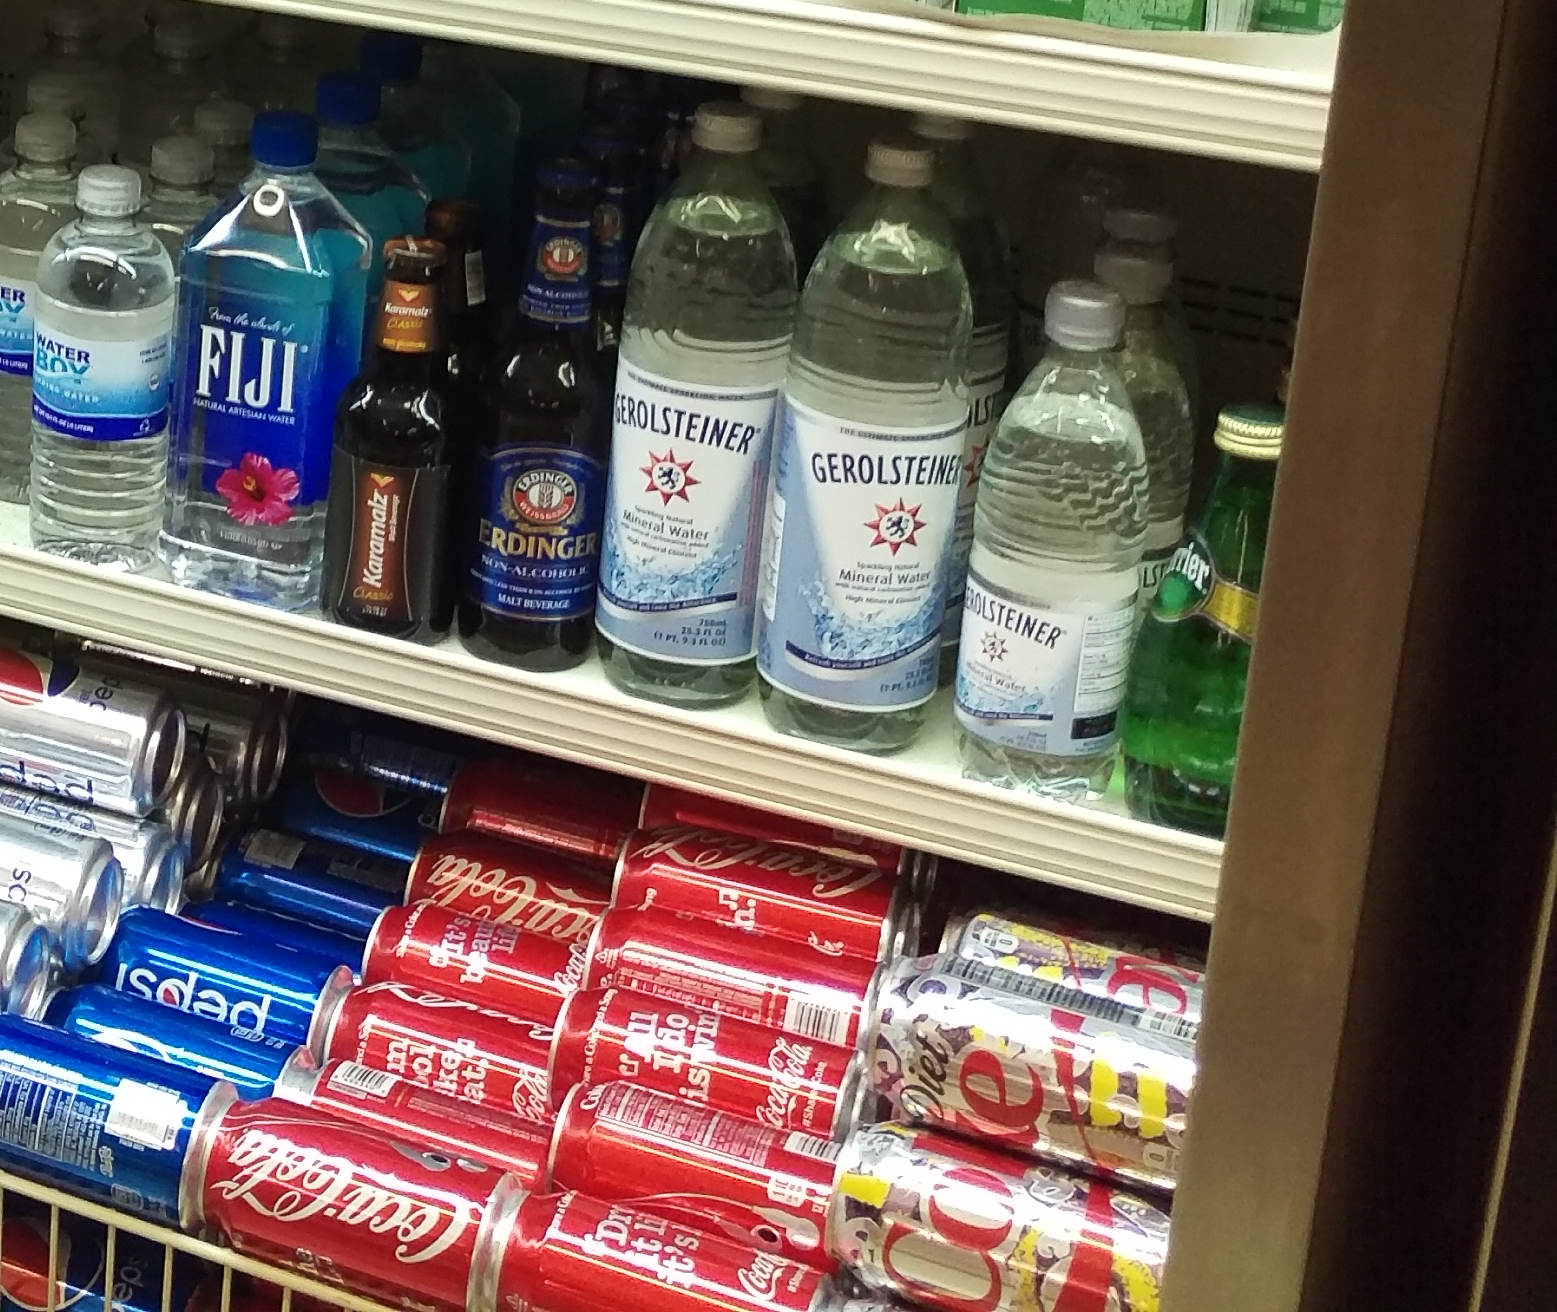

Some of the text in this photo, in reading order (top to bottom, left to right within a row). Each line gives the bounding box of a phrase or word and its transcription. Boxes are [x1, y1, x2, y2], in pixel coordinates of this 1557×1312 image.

[384, 302, 432, 318] Karamalz
[34, 347, 91, 376] BOY
[36, 332, 91, 364] WATER
[195, 323, 299, 413] FIJI
[193, 397, 295, 426] NATURAL ARTESIAN WATER
[615, 392, 755, 456] GEROLSTEINER
[517, 470, 573, 496] ERDINGER
[811, 451, 962, 486] GEROLSTEINER
[363, 487, 387, 588] Karamalz
[478, 518, 597, 561] ERDINGER
[622, 509, 665, 535] Mineral
[669, 524, 709, 540] Water
[481, 554, 589, 578] NON-ALCOHOLIC
[838, 567, 932, 586] Mineral Water
[1171, 541, 1211, 594] rrier
[353, 585, 395, 603] Classic
[497, 592, 571, 609] MALT BEVERAGE
[965, 587, 1063, 650] EROLSTEINER
[115, 961, 272, 1035] pepsi
[756, 1037, 813, 1127] Coca-Cola
[900, 1032, 949, 1119] Diet
[211, 1127, 467, 1265] Coca-Cola
